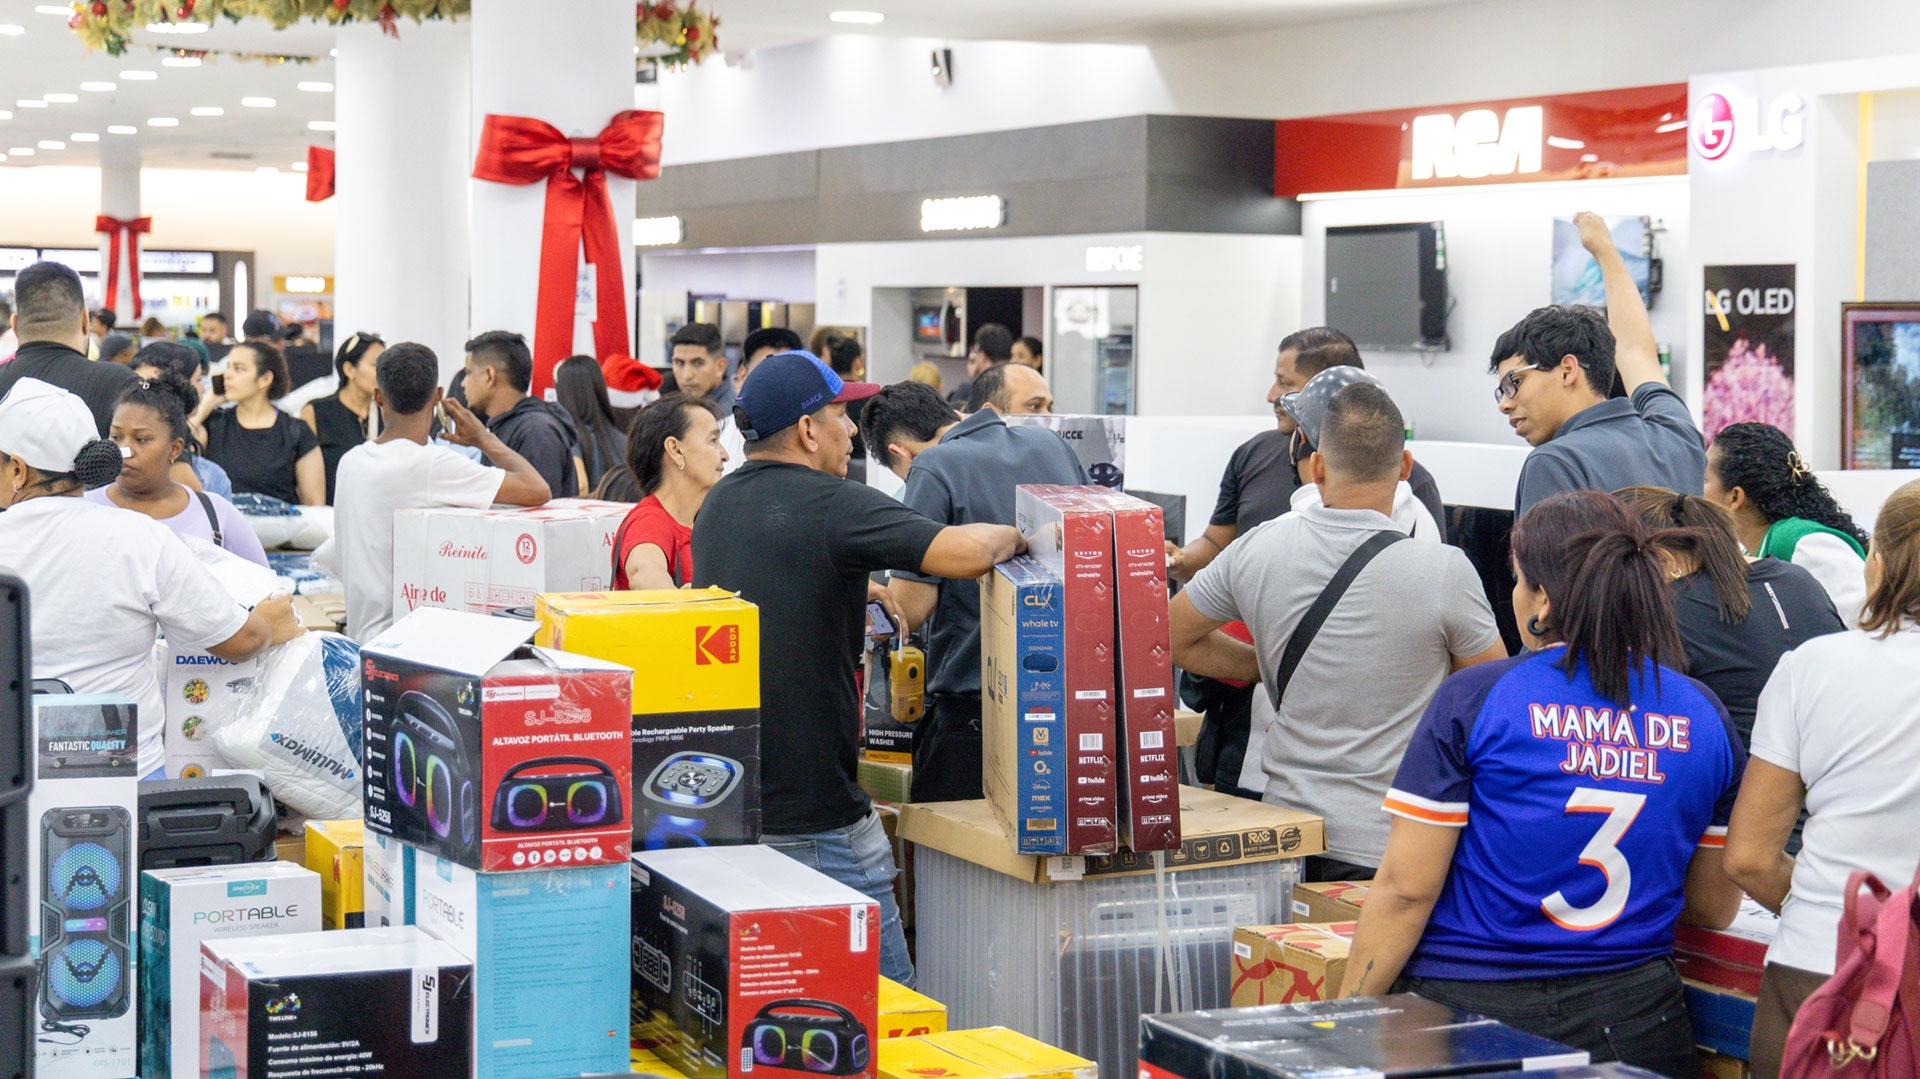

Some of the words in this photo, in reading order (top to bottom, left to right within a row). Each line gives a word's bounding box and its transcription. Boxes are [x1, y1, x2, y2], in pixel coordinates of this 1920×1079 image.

[1751, 93, 1804, 151] LG
[1412, 106, 1543, 180] RCA
[1705, 289, 1731, 314] LG
[1736, 288, 1794, 315] OLED
[430, 585, 446, 602] de
[729, 627, 737, 661] KODAK
[493, 735, 530, 746] ALTAVOZ
[531, 732, 572, 744] PORTÁTIL
[574, 731, 623, 741] BLUETOOTH
[642, 727, 688, 737] Rechargeable
[689, 725, 706, 735] Party
[707, 724, 734, 733] Speaker
[868, 729, 884, 737] HIGH
[885, 729, 913, 738] PRESSURE
[1645, 713, 1690, 751] DE
[48, 740, 90, 752] FANTASTIC
[90, 739, 126, 751] QUALITY
[869, 738, 894, 746] WASHER
[275, 733, 352, 780] MultiMax
[1140, 754, 1165, 763] NETFLIX
[1560, 742, 1665, 784] JADIEL
[567, 837, 598, 846] BLUETOOTH
[1541, 787, 1647, 931] 3
[194, 904, 299, 925] PORTABLE
[213, 924, 249, 933] WIRELESS
[250, 921, 279, 930] SPEAKER
[268, 1057, 298, 1065] Consumo
[299, 1055, 324, 1063] máximo
[268, 1070, 301, 1079] Respuesta
[365, 1063, 384, 1071] 20kHz
